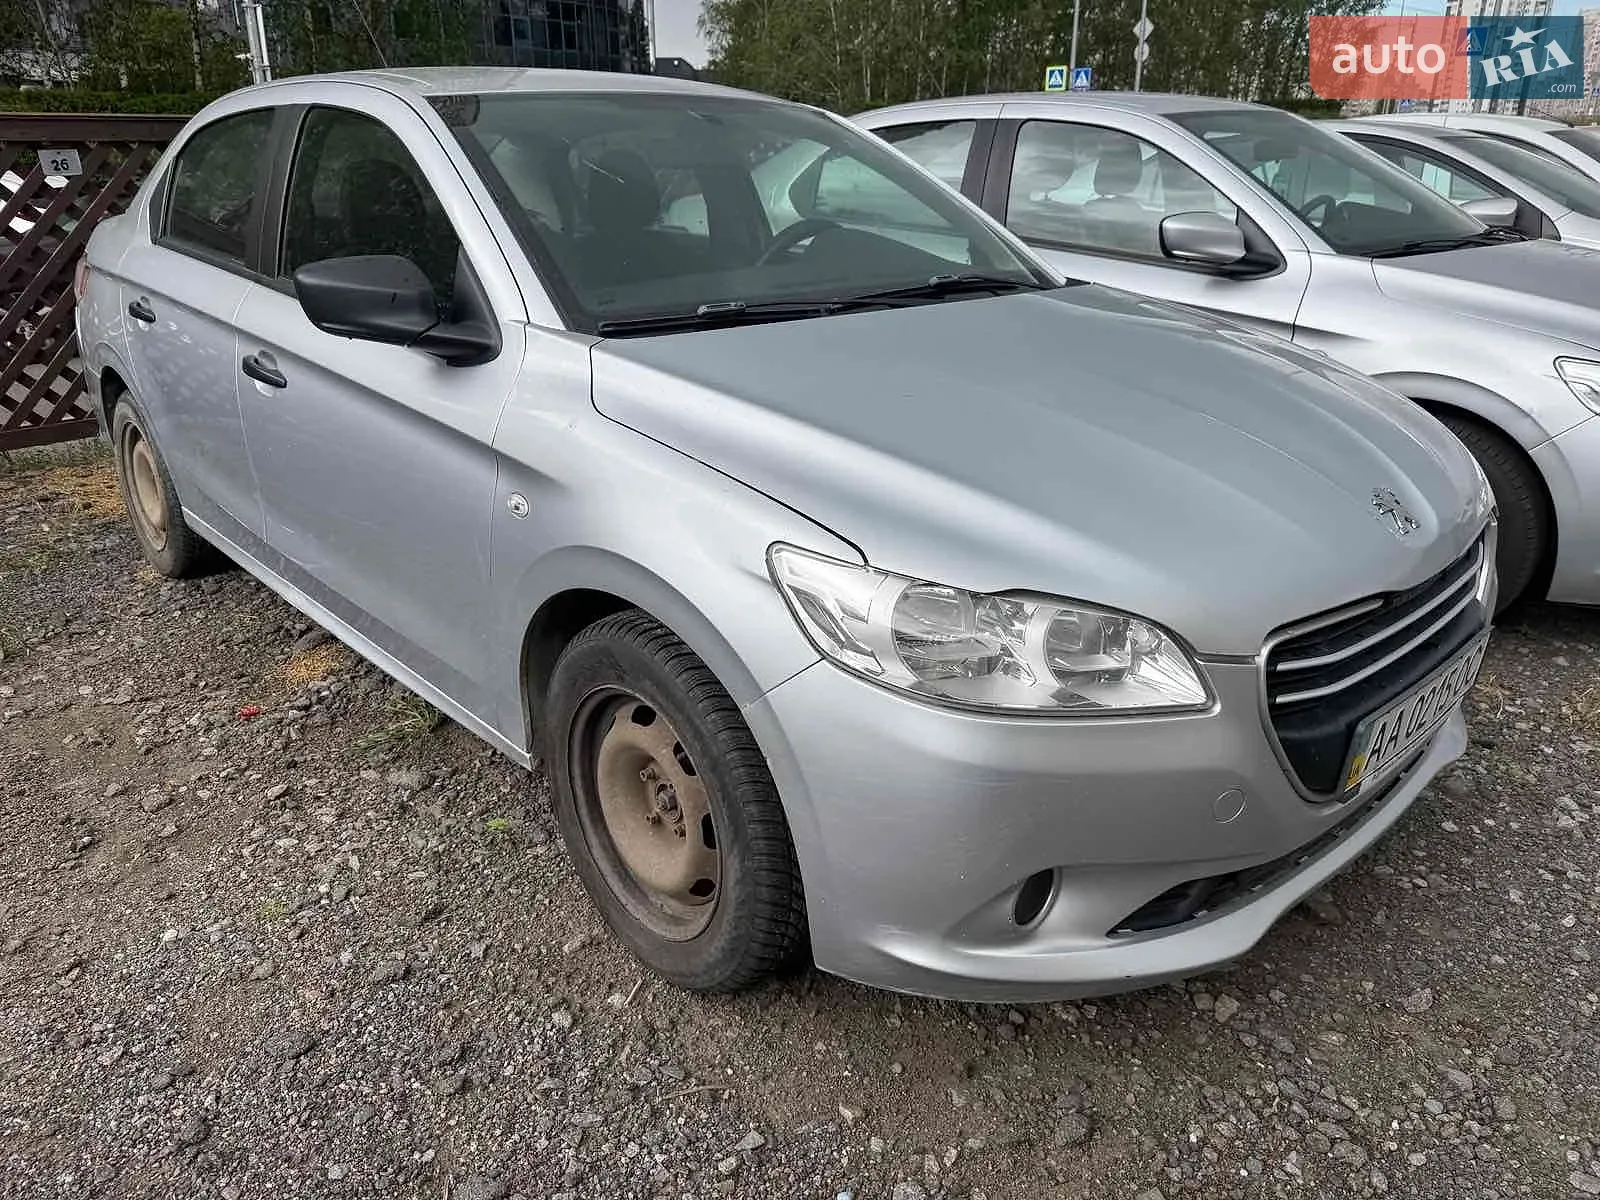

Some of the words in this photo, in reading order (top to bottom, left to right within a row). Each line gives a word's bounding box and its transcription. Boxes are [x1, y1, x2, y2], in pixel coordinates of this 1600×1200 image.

[50, 158, 70, 172] 26
[1363, 708, 1405, 771] AA
[1405, 666, 1459, 739] 0215
